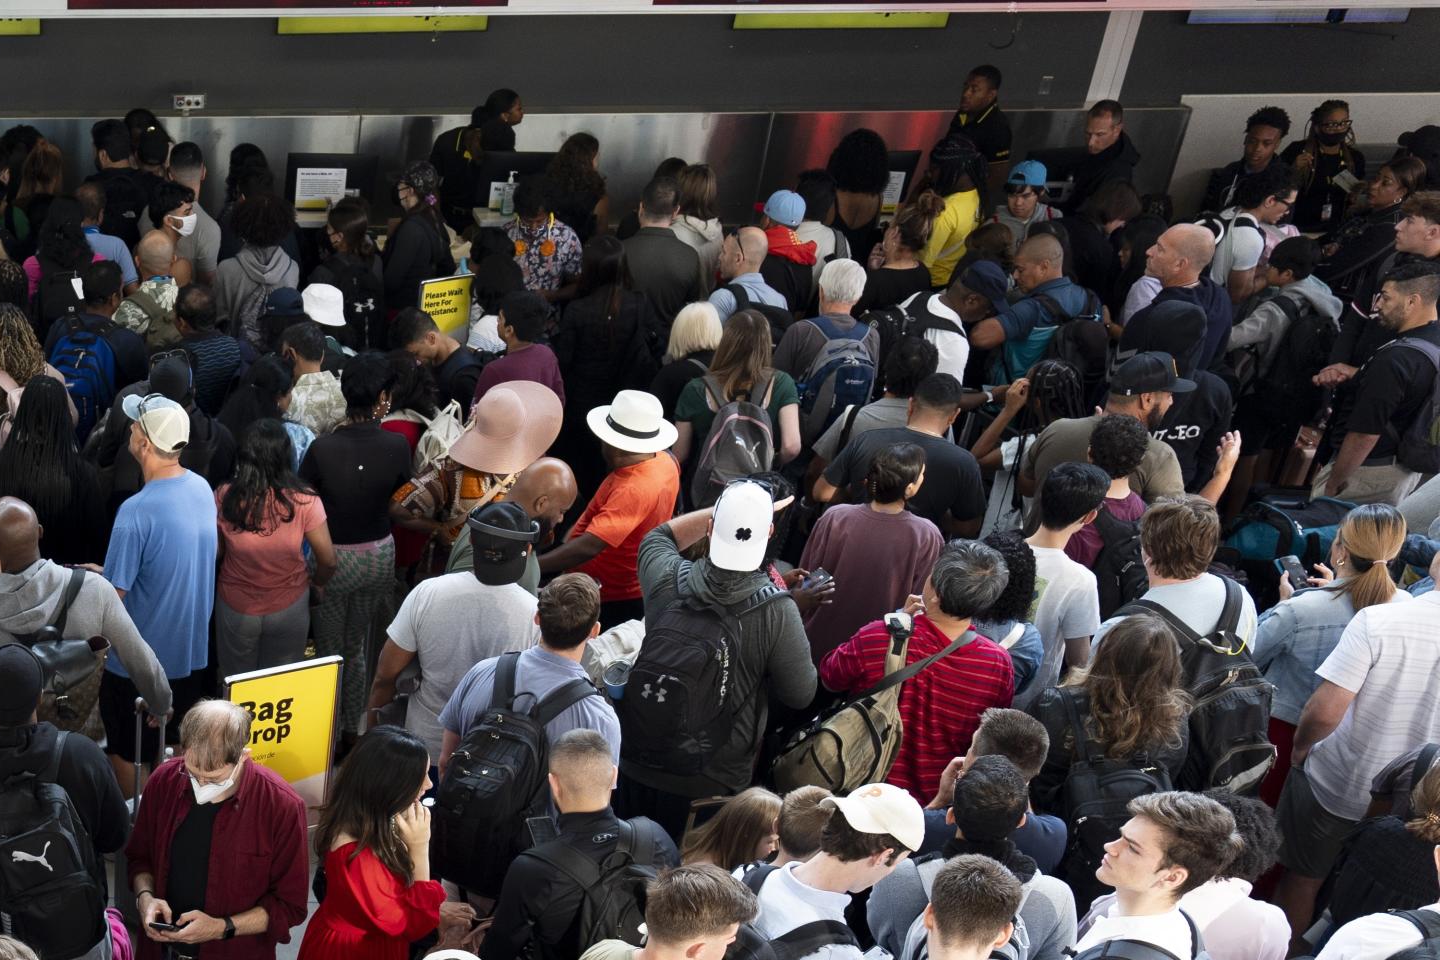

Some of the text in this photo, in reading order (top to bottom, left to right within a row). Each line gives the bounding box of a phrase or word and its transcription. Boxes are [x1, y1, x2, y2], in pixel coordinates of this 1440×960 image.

[424, 288, 464, 300] Please Wait
[425, 306, 458, 316] sistance
[240, 698, 294, 724] Bag
[248, 724, 291, 744] rop
